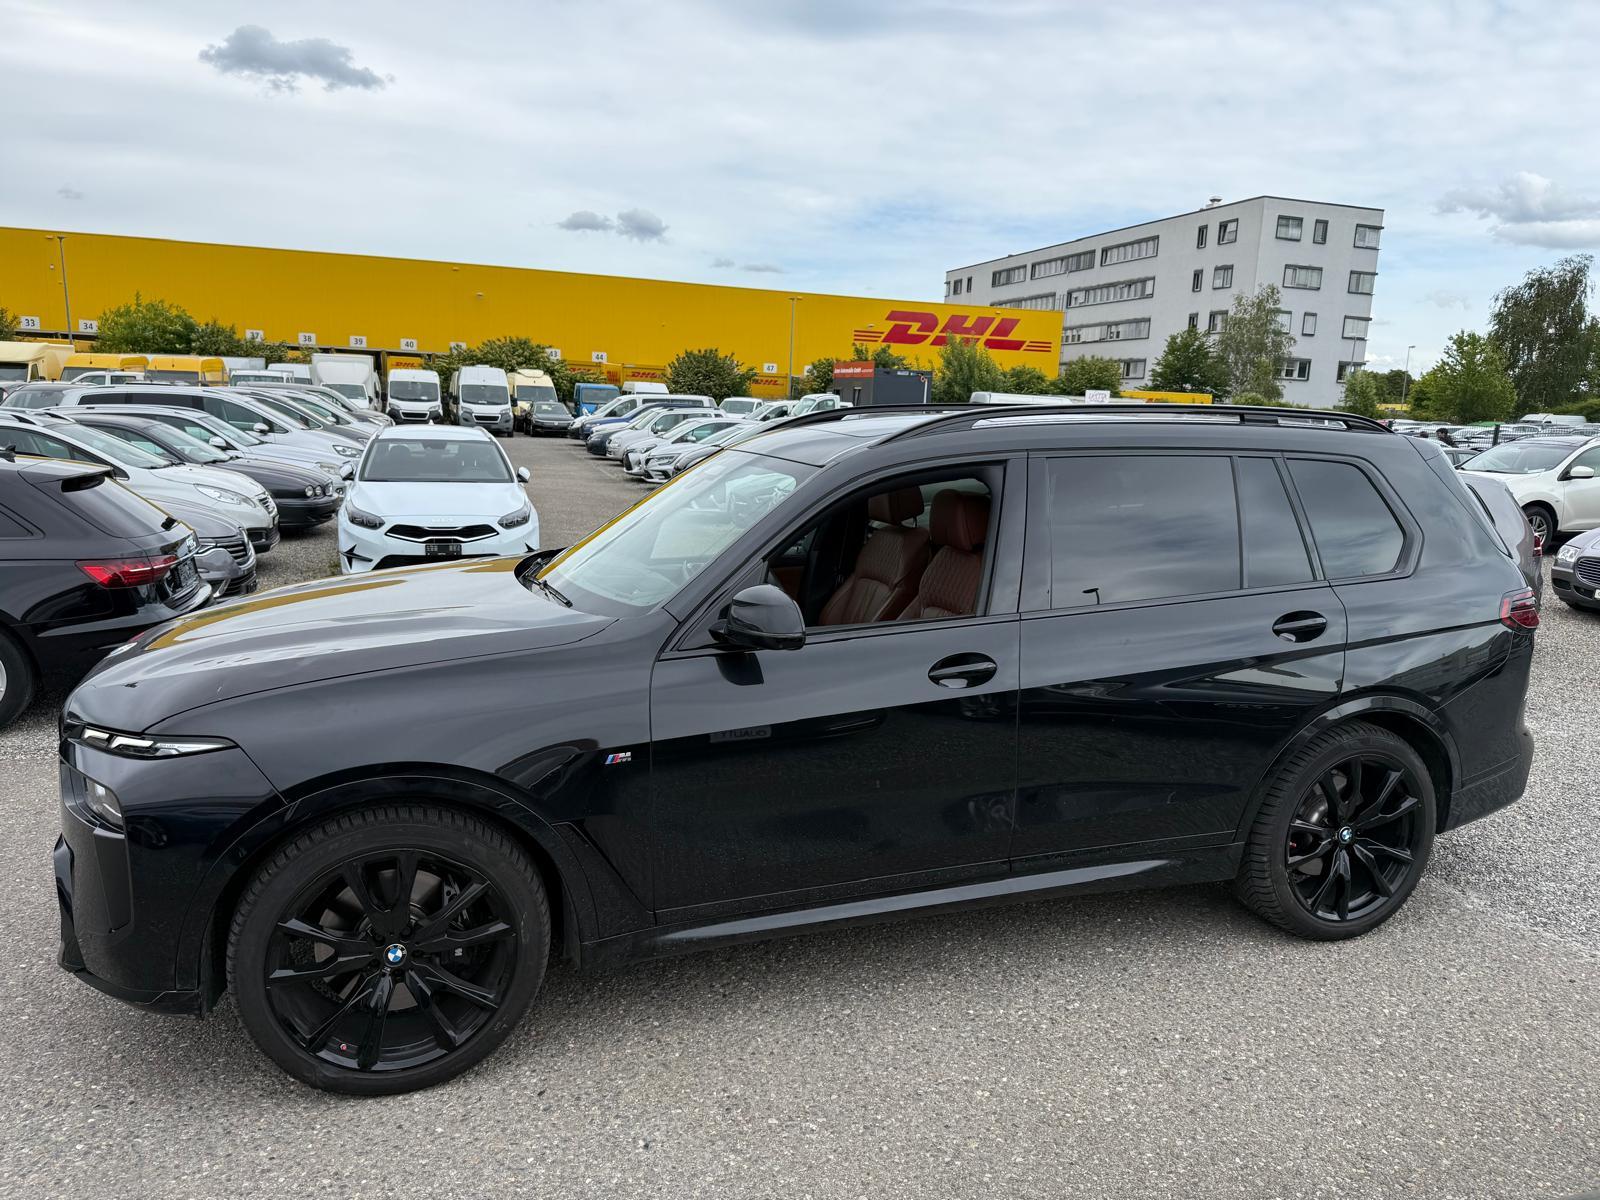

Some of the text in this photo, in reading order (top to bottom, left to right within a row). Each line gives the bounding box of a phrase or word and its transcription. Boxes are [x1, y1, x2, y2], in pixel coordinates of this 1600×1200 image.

[24, 318, 36, 327] 33
[83, 321, 94, 330] 34
[881, 310, 1027, 351] DHL
[249, 331, 260, 340] 37
[303, 334, 313, 343] 38
[354, 337, 364, 345] 39
[404, 340, 415, 349] 40
[550, 350, 558, 358] 43
[595, 353, 604, 361] 44
